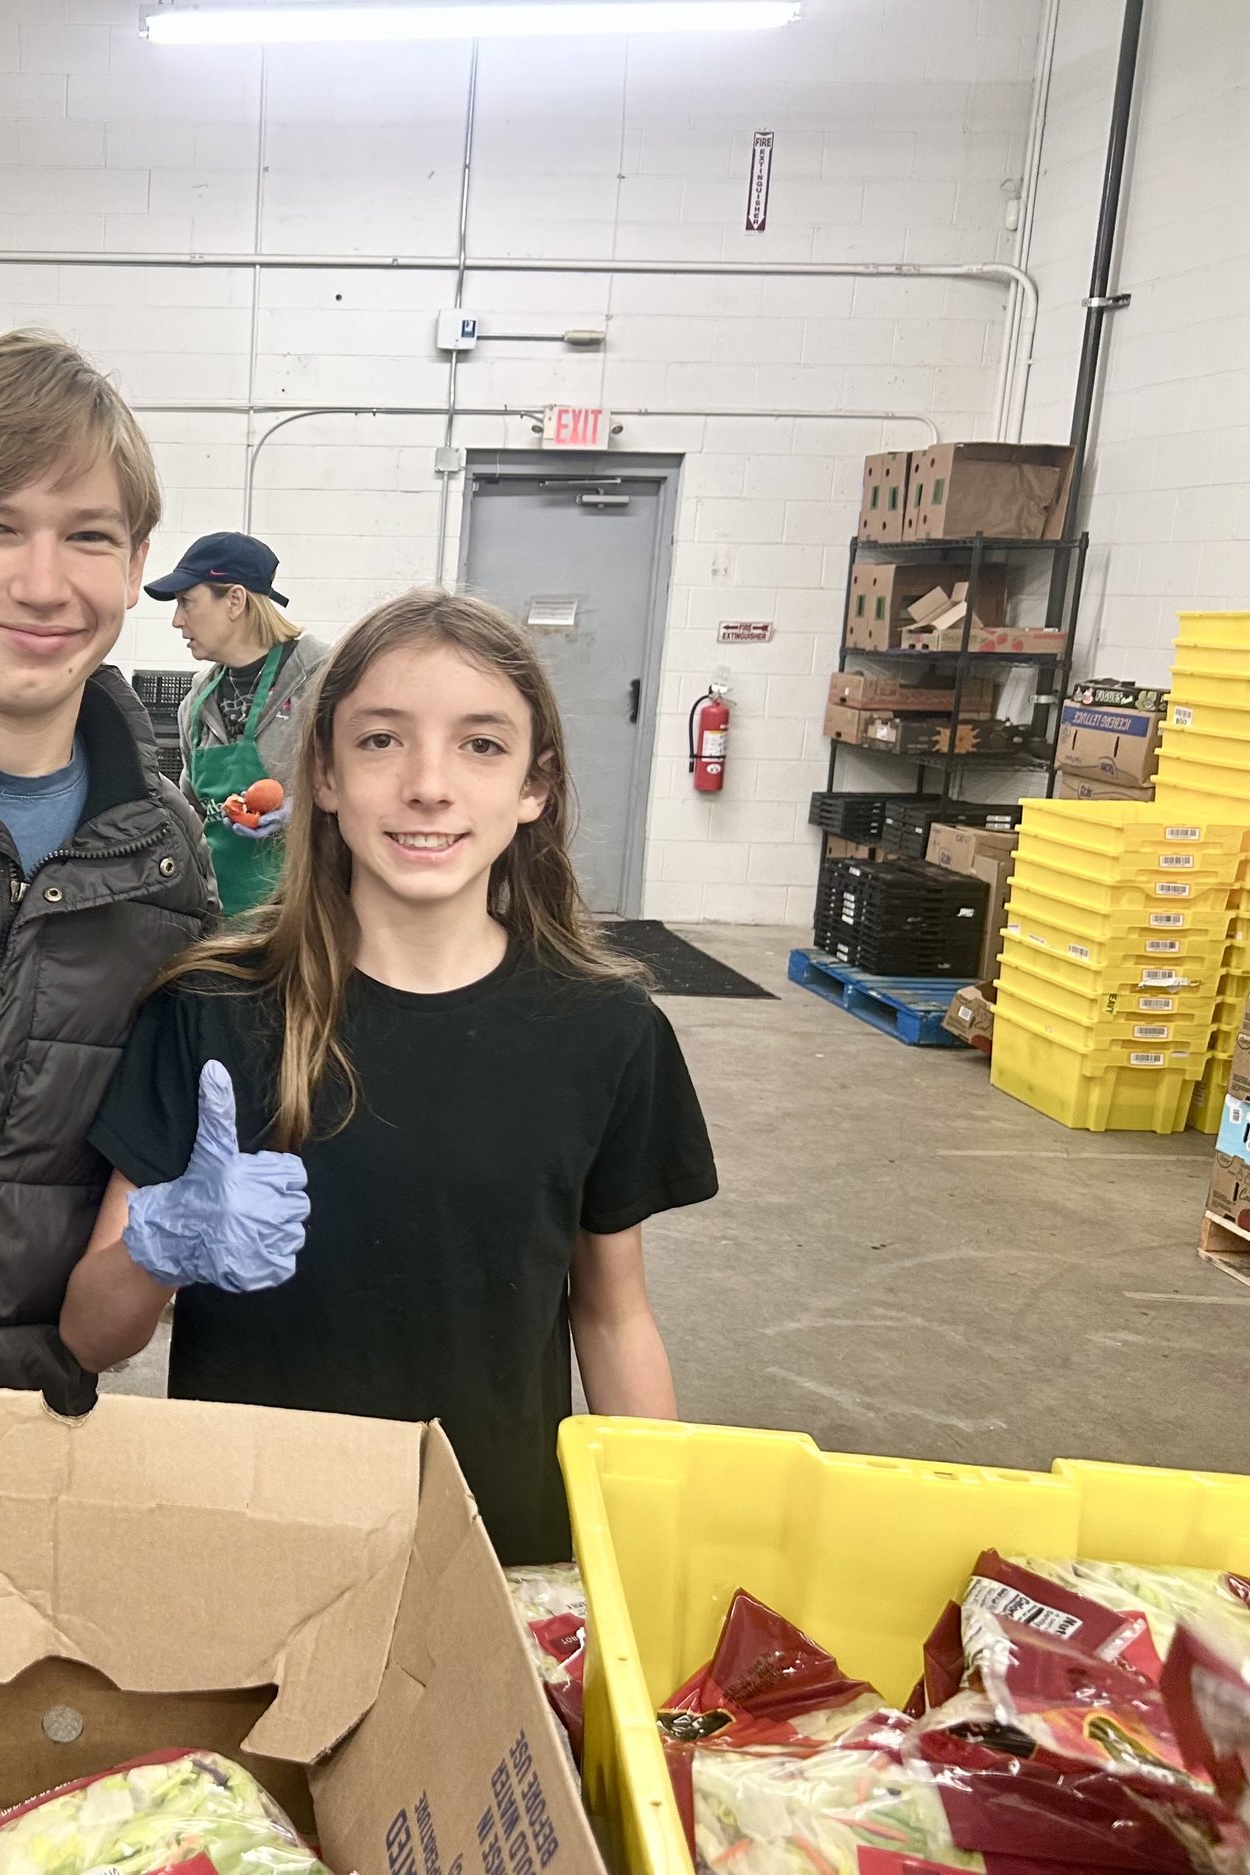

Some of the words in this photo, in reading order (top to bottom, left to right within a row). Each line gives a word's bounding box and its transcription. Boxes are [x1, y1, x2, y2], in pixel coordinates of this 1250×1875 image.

[754, 137, 771, 147] FIRE
[753, 149, 765, 225] EXTINGUISHER
[555, 408, 603, 446] EXIT
[509, 1728, 532, 1785] USE
[491, 1758, 520, 1843] WATER
[521, 1770, 559, 1869] BEFORE
